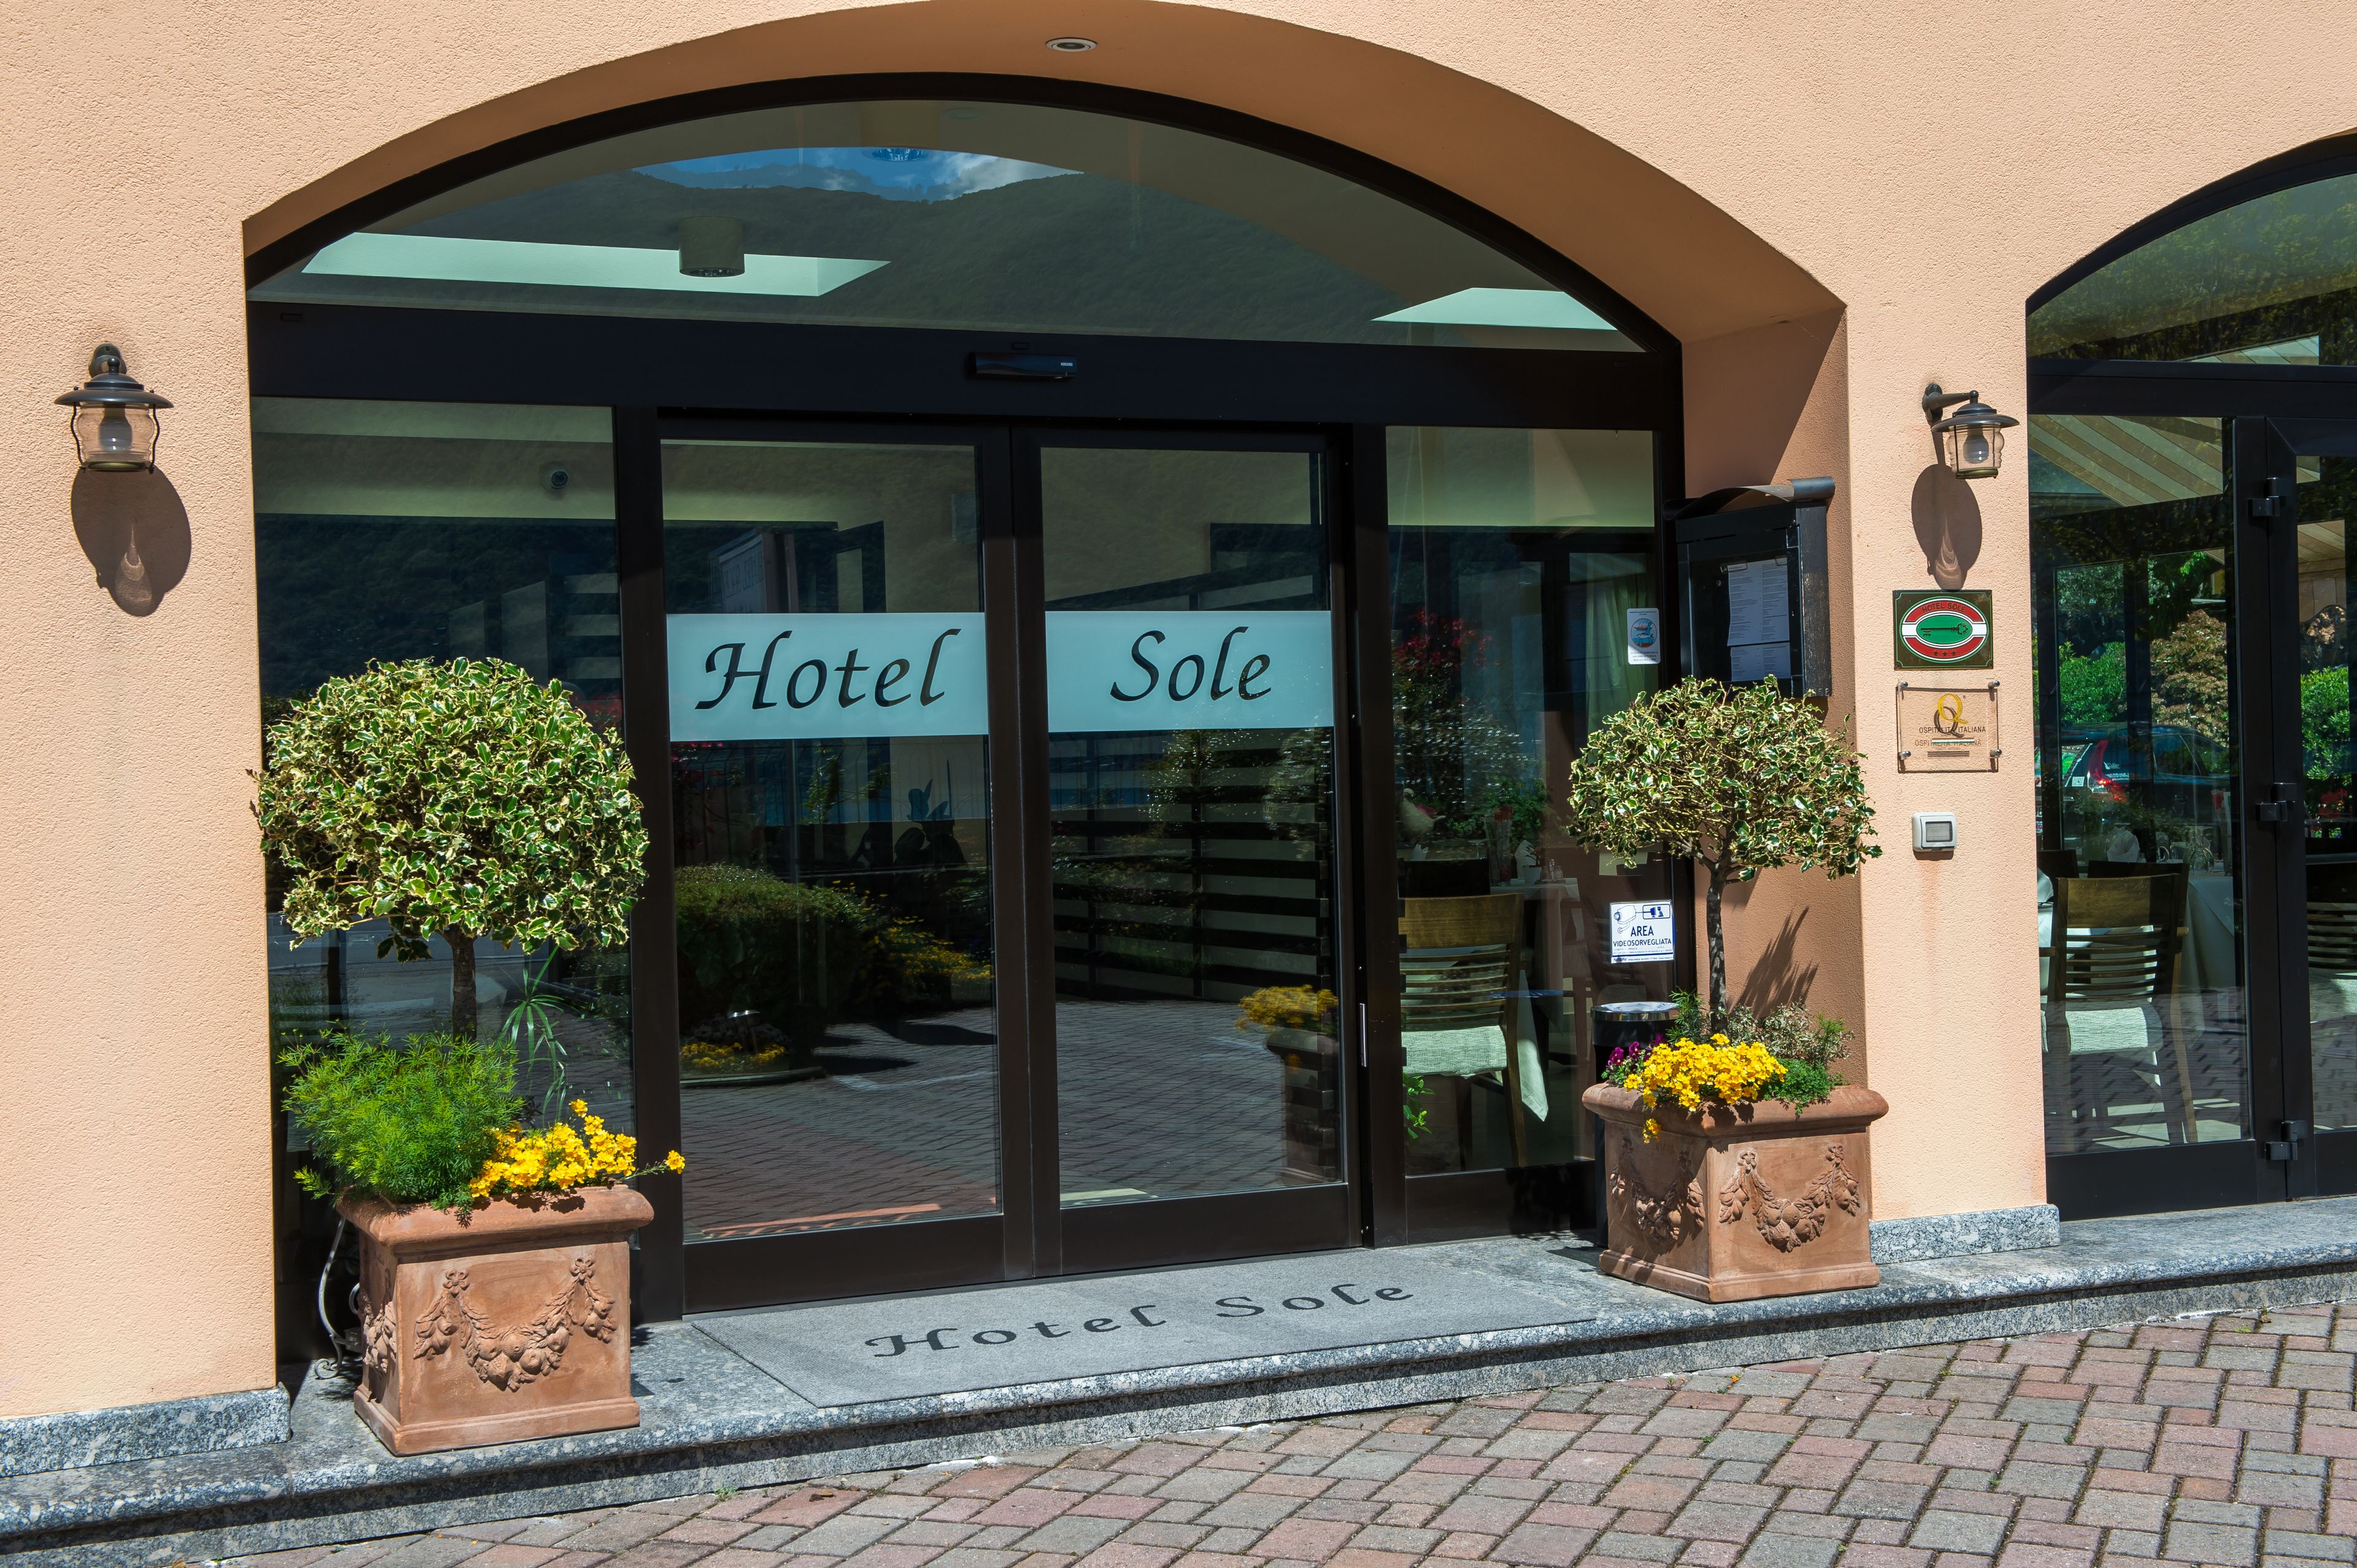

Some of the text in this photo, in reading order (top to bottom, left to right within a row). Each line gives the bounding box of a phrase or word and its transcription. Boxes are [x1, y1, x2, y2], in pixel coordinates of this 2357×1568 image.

[1922, 602, 1965, 612] HOTEL SOLE
[694, 626, 1272, 710] Hotel Sole
[1630, 925, 1654, 937] AREA
[1613, 938, 1672, 947] VIDEOSORVEGLIATA
[865, 1283, 1414, 1358] Hotel Sole
